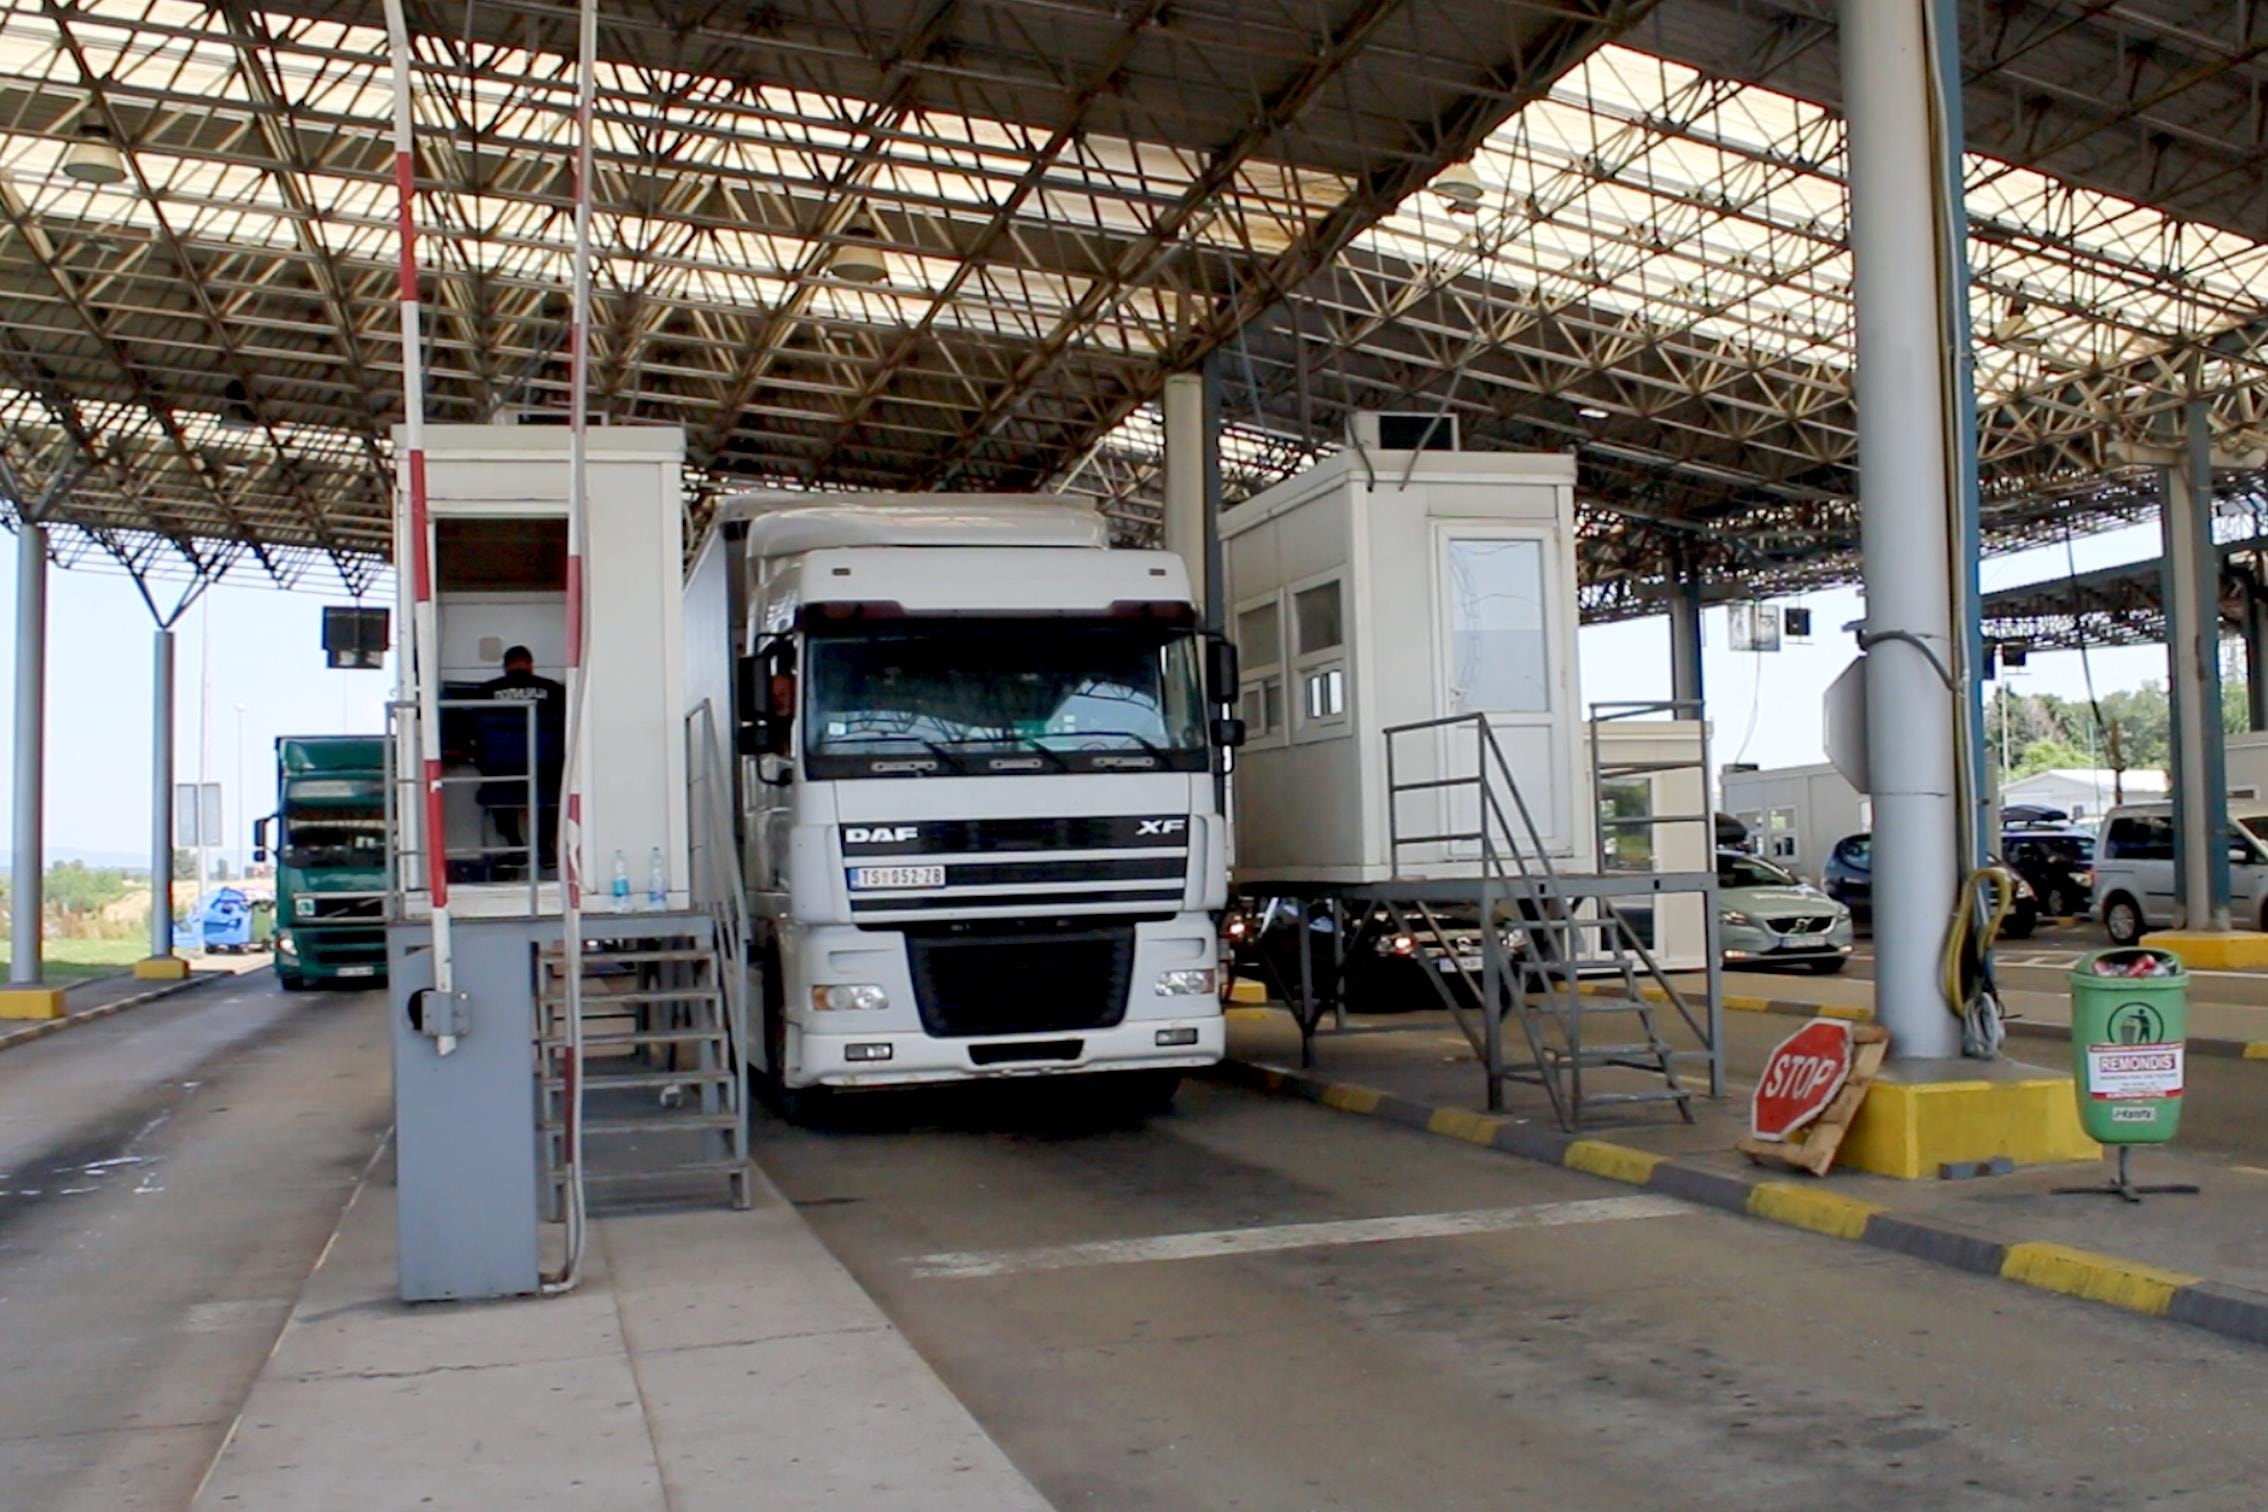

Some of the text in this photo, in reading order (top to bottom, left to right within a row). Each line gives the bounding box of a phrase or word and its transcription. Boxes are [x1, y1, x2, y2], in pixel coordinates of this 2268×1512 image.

[845, 827, 918, 843] DAF
[1136, 819, 1186, 835] XF
[2100, 1055, 2173, 1072] REMONDIS
[1765, 1054, 1837, 1099] STOP
